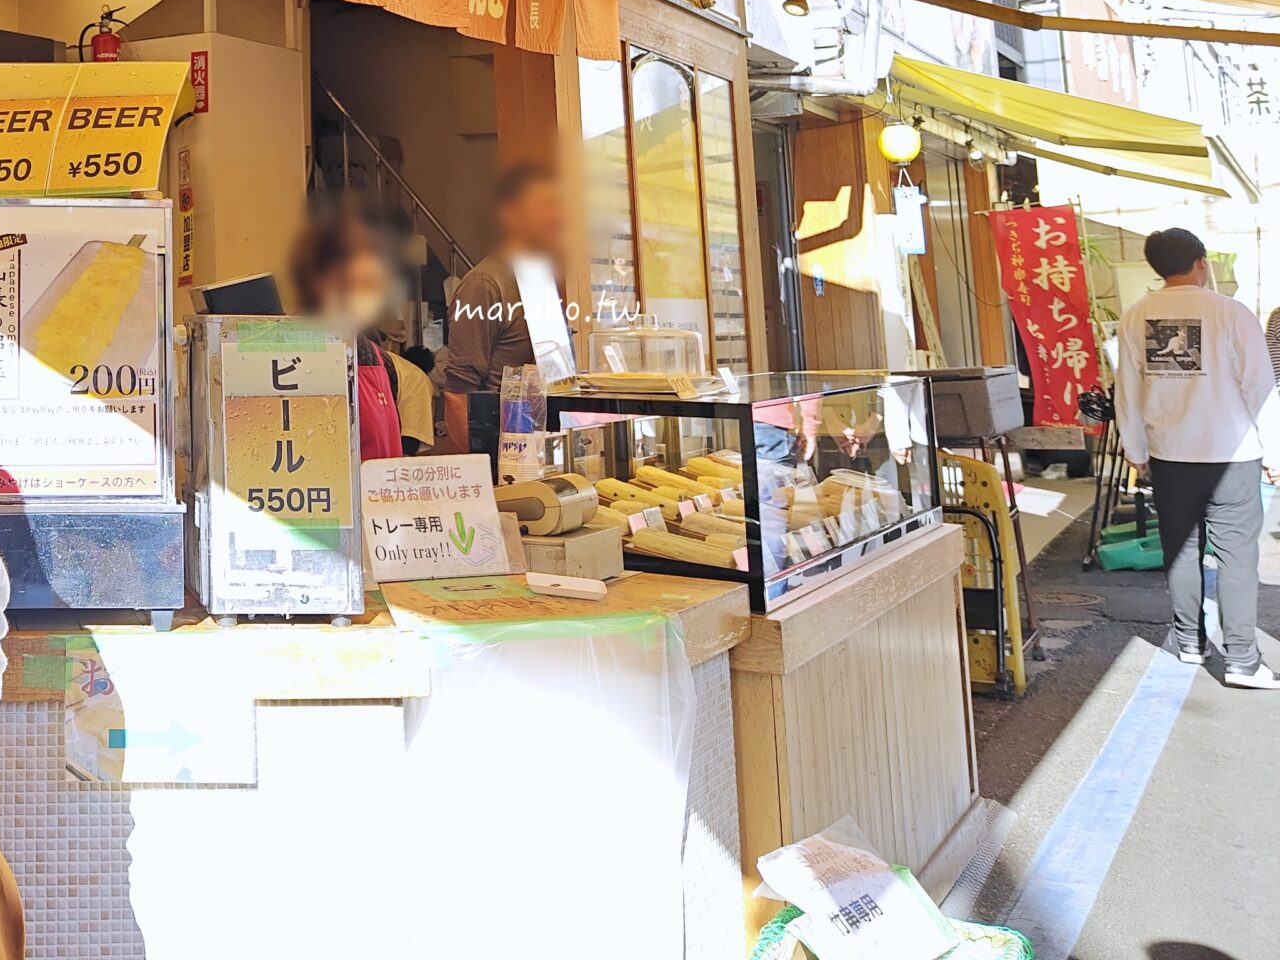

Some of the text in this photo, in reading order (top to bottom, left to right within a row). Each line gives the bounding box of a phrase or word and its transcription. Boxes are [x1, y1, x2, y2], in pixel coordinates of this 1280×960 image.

[193, 55, 206, 101] 消火器
[67, 106, 164, 130] BEER
[68, 151, 142, 178] ¥550
[69, 364, 157, 396] 200円
[271, 357, 304, 473] ビール
[386, 466, 462, 483] ゴミの分別に
[247, 488, 331, 513] 550円
[368, 484, 483, 503] ご協力お願いします
[372, 516, 443, 535] トレー専用
[375, 542, 452, 565] Only tray!!
